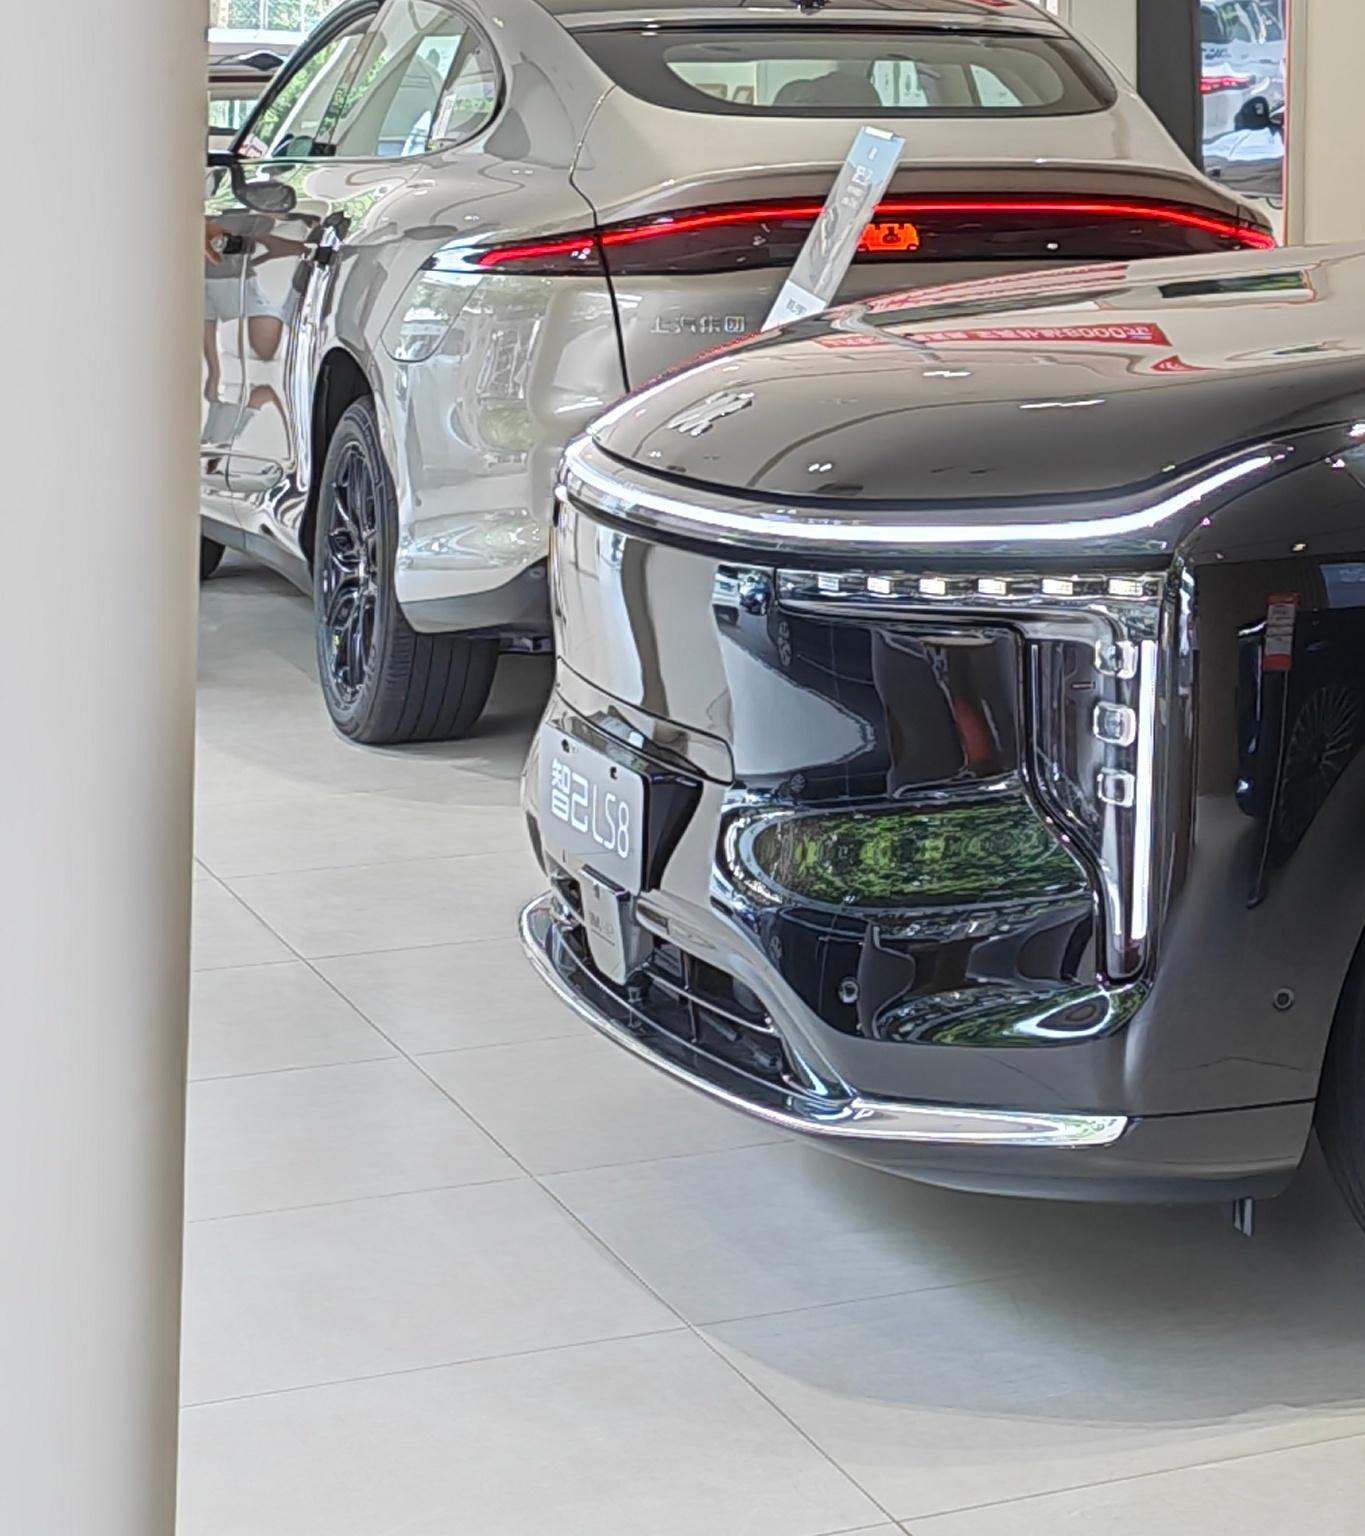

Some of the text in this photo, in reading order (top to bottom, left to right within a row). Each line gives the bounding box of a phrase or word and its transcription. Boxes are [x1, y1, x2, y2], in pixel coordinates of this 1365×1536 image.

[650, 315, 745, 334] 上汽集团
[551, 757, 630, 859] 智己LS8
